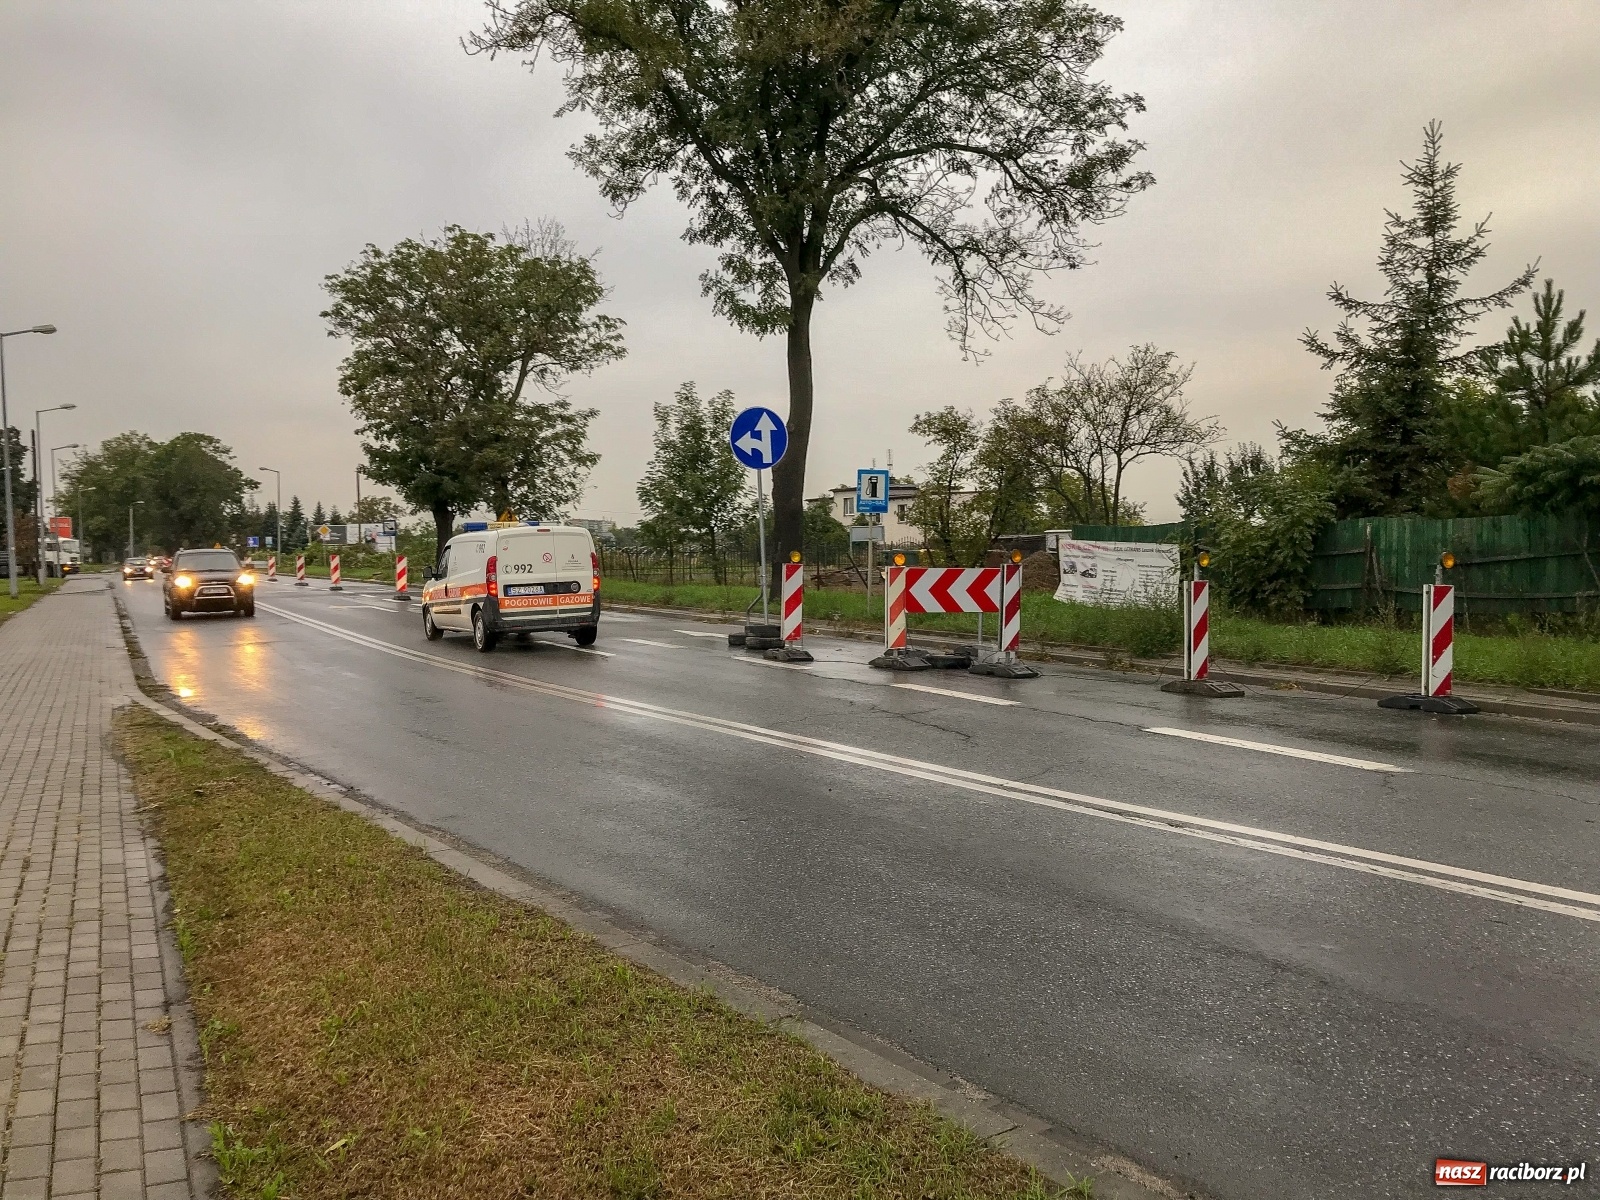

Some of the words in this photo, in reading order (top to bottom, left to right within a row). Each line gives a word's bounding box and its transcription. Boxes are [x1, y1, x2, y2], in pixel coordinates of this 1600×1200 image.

[513, 564, 533, 574] 992
[505, 598, 553, 607] POGOTOWIE
[561, 595, 590, 604] GAZOWE
